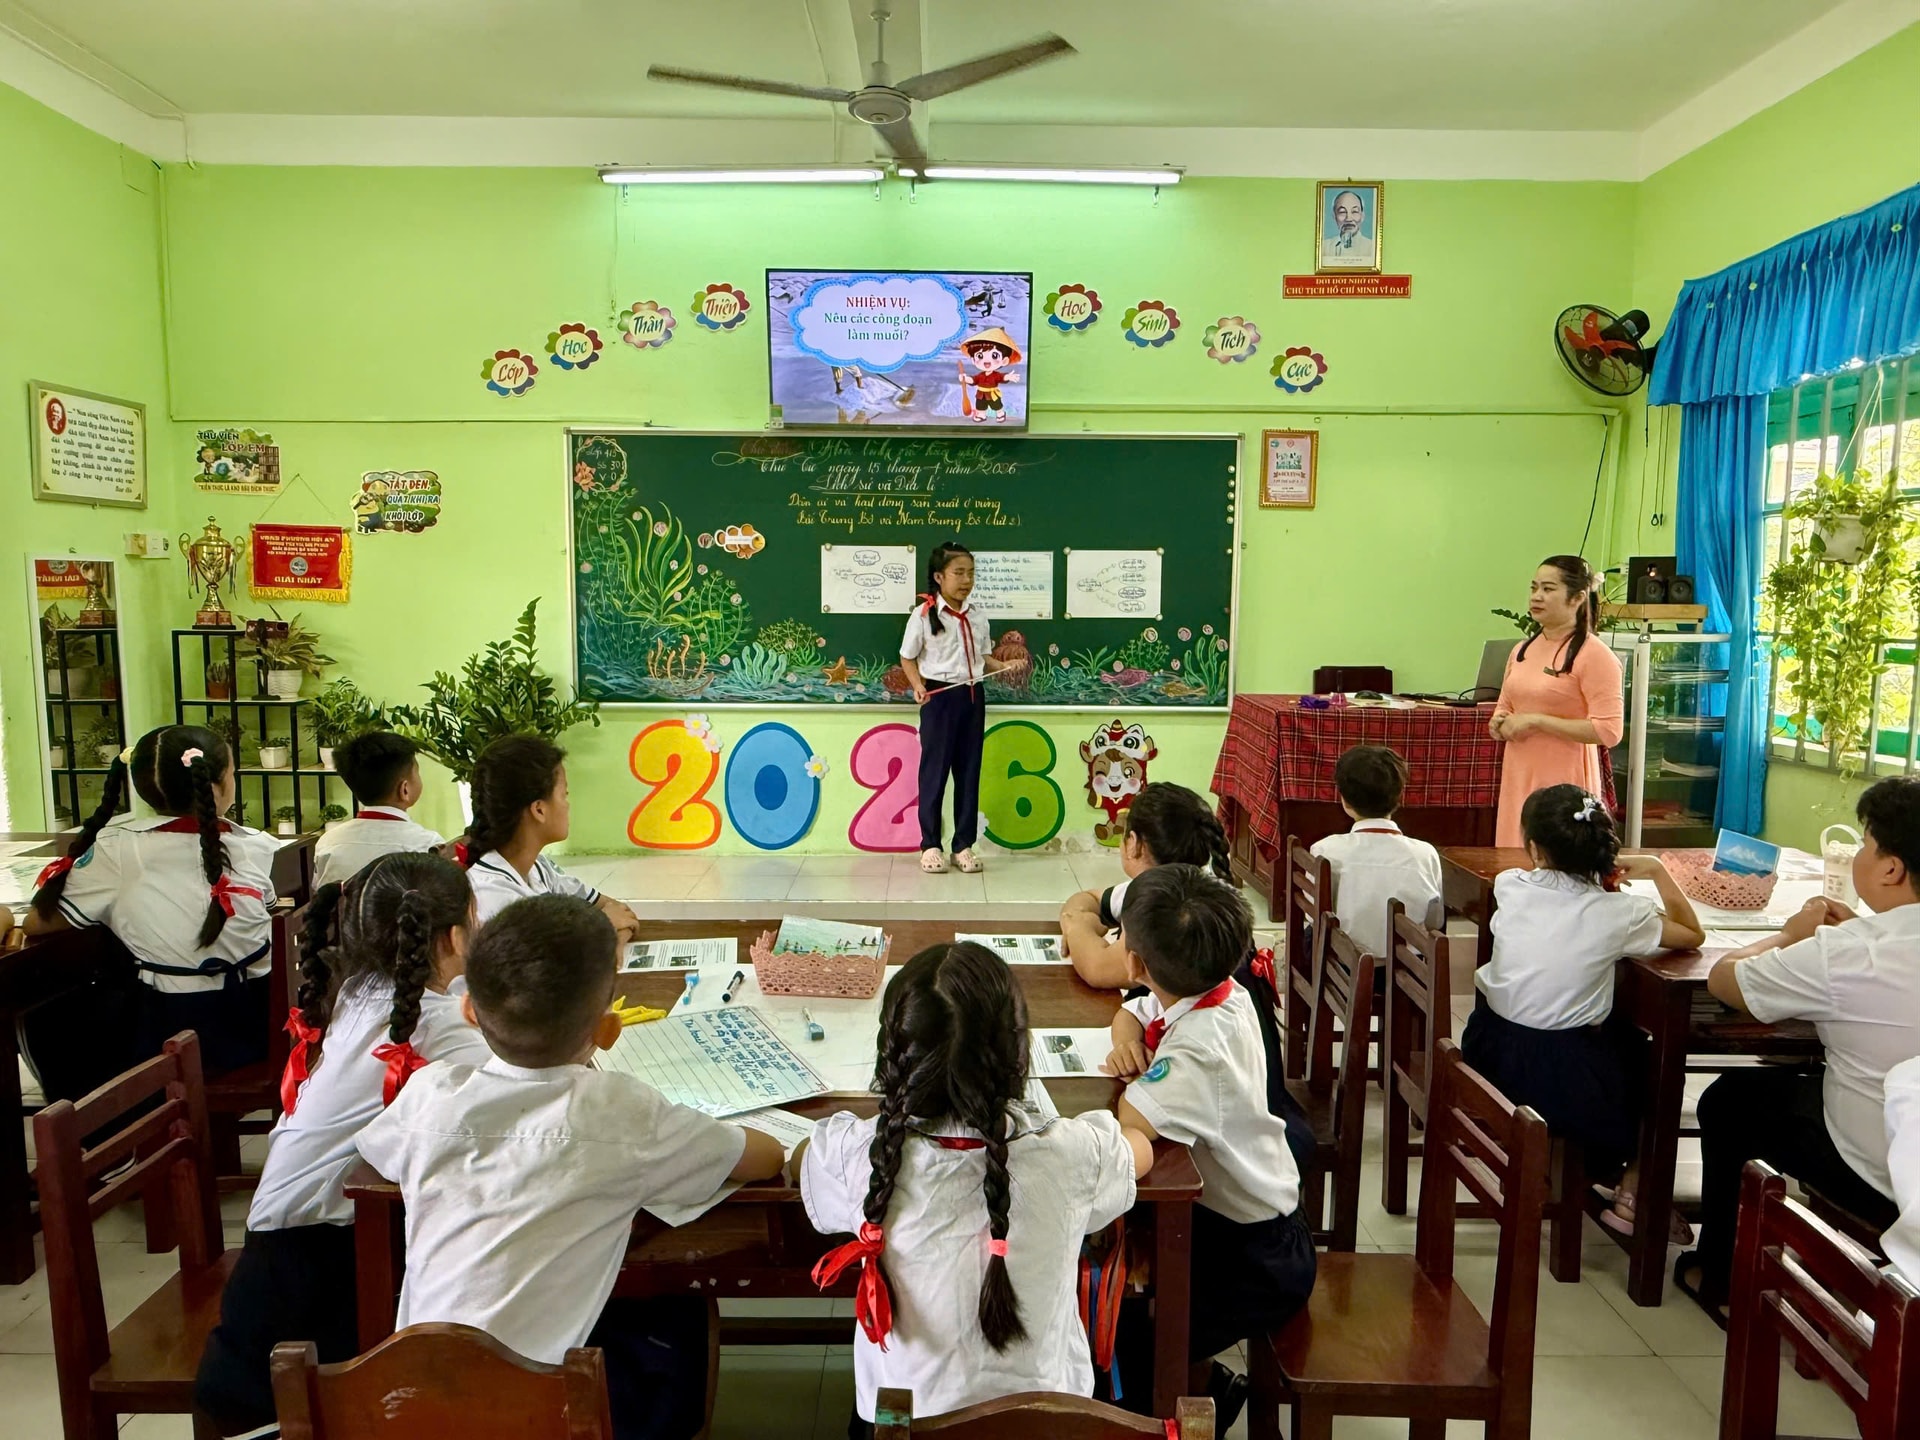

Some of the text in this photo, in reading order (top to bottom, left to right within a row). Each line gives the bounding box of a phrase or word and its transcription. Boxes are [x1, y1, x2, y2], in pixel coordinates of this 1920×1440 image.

[1286, 285, 1305, 295] CHỦ
[1306, 287, 1325, 296] TỊCH
[1326, 285, 1339, 294] HỒ
[1340, 285, 1355, 294] CHÍ
[1356, 286, 1378, 295] MINH
[846, 294, 911, 311] NHIỆM VỤ:
[823, 312, 933, 327] Nêu các công đoạn
[497, 298, 738, 385] Lớp Học Thân Thiện
[847, 328, 910, 341] làm muối?
[1061, 300, 1313, 382] Học Sinh Tích Cực
[218, 430, 240, 441] VIỆN
[248, 444, 266, 453] EM
[828, 462, 862, 485] ngày
[867, 462, 880, 474] 15
[979, 461, 1017, 476] 2026
[877, 479, 891, 491] và
[426, 495, 440, 504] RA
[787, 492, 811, 507] Dân
[834, 497, 849, 507] và
[910, 496, 930, 508] sản
[934, 494, 960, 508] xuất
[975, 496, 1001, 516] vùng
[385, 507, 424, 521] KHỎI LỚP
[819, 509, 854, 534] Trung
[879, 515, 892, 525] và
[896, 511, 924, 526] Nam
[927, 510, 961, 534] Trung
[627, 718, 1067, 854] 2026
